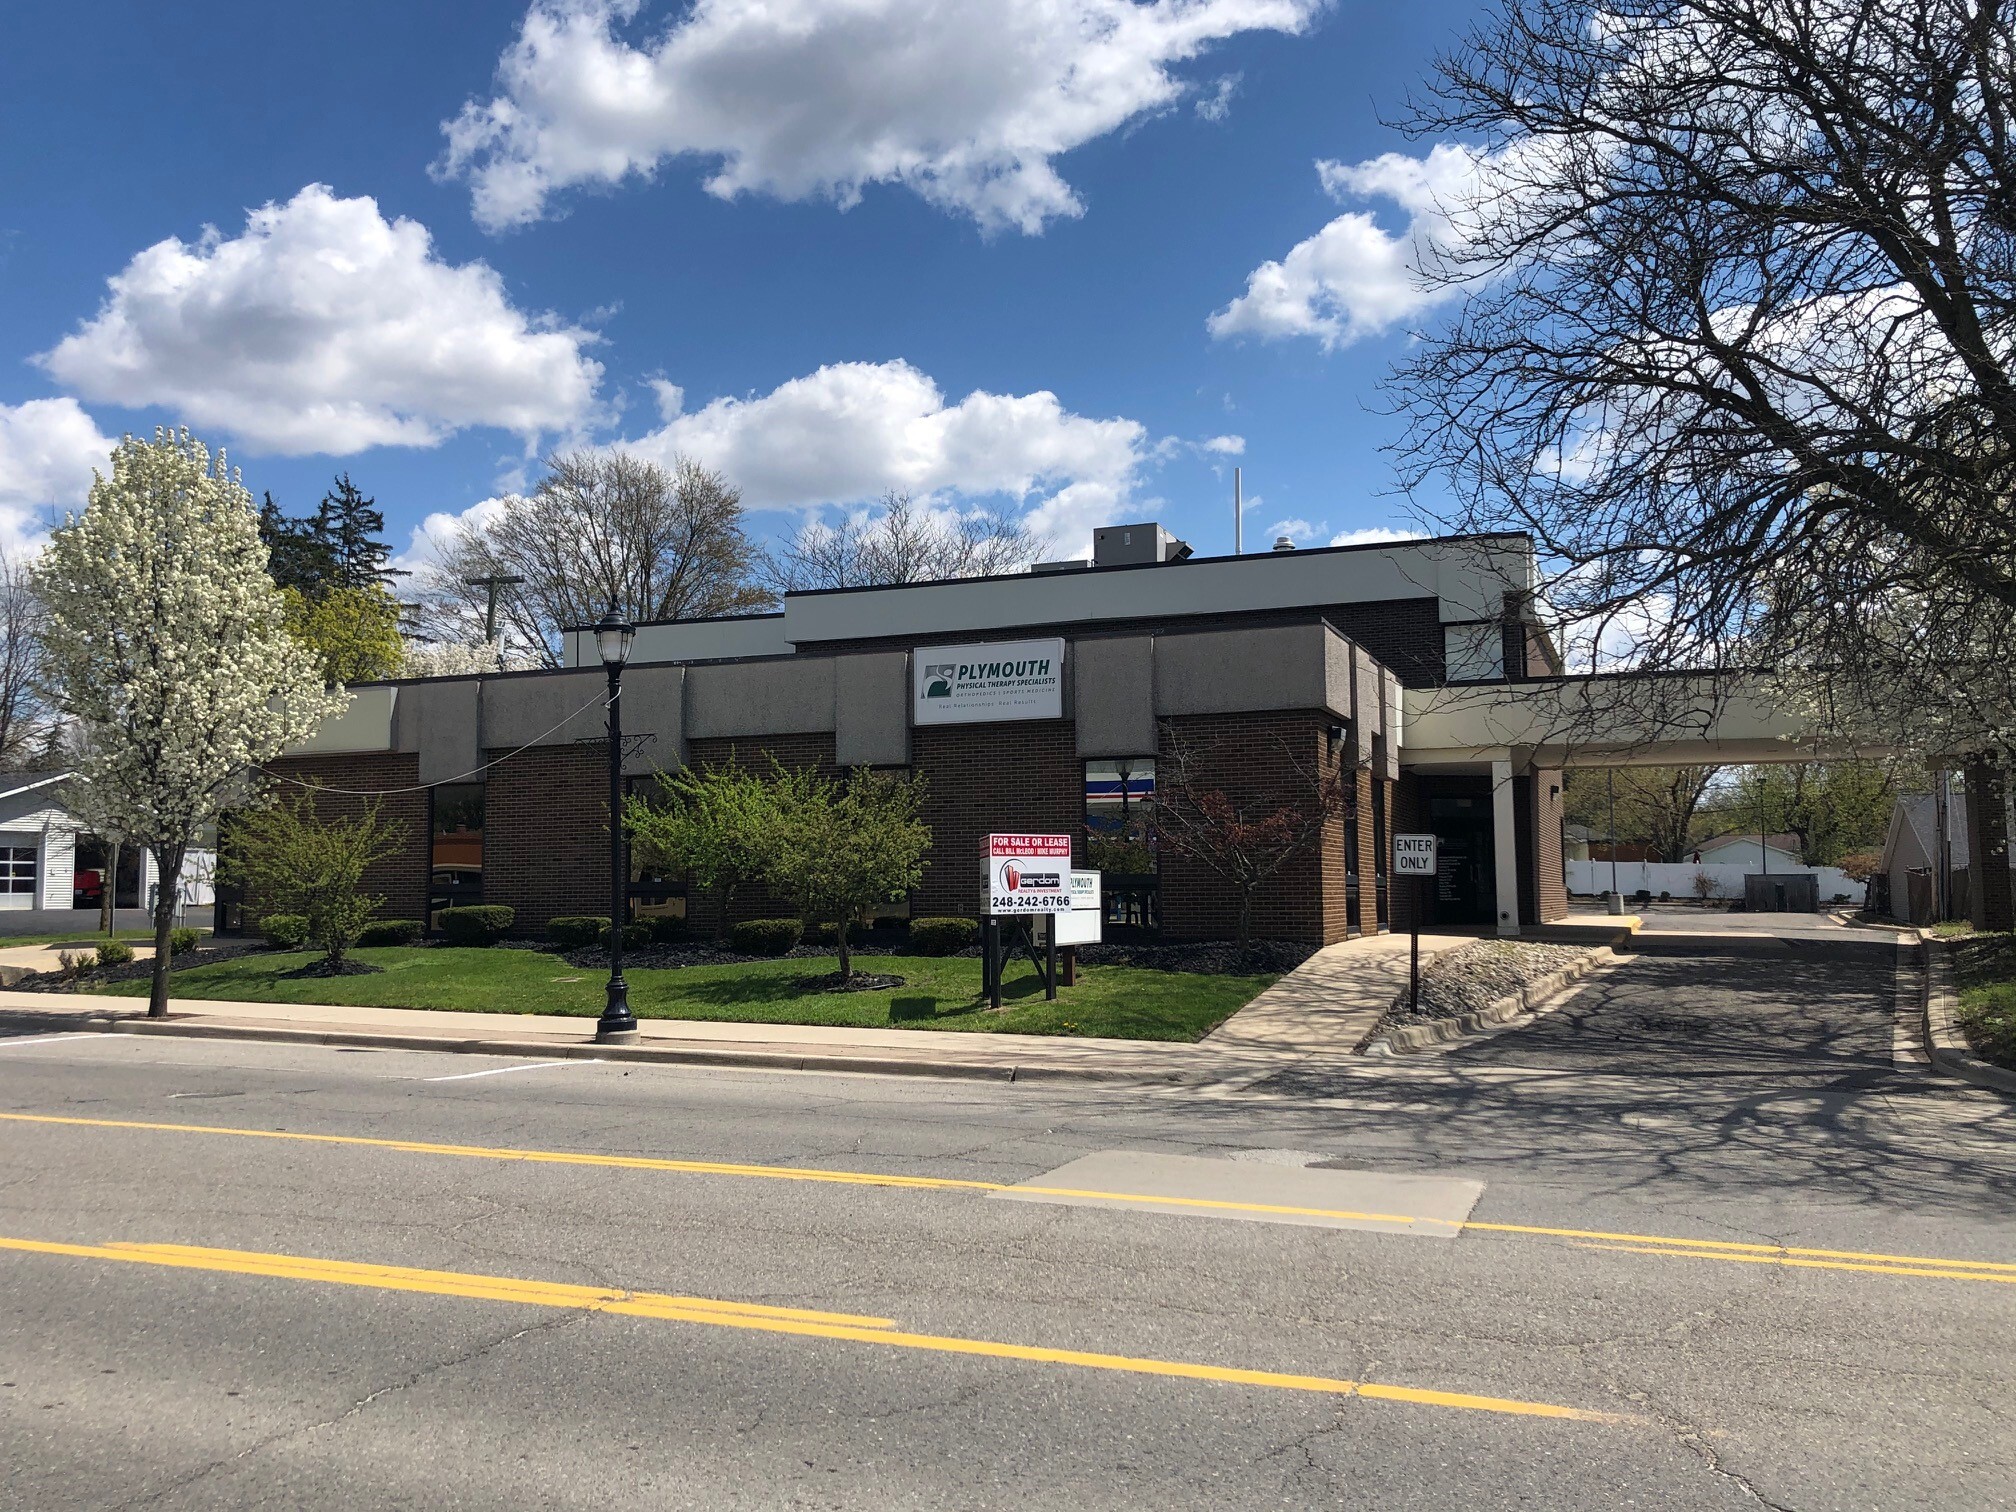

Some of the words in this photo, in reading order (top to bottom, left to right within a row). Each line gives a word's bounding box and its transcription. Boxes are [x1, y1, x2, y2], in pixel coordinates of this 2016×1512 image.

[957, 659, 1050, 681] PLYMOUTH
[956, 681, 986, 690] PHYSICAL
[987, 679, 1016, 688] THERAPY
[1016, 677, 1056, 687] SPECIALISTS
[993, 837, 1009, 846] FOR
[1010, 837, 1030, 846] SALE
[1031, 837, 1043, 846] OR
[1044, 837, 1068, 847] LEASE
[1396, 839, 1432, 851] ENTER
[992, 847, 1005, 855] CALL
[1005, 847, 1016, 855] BILL
[1037, 847, 1048, 855] MIKE
[1049, 847, 1068, 855] MURPHY
[1400, 856, 1429, 869] ONLY
[992, 896, 1070, 907] 248-242-6766
